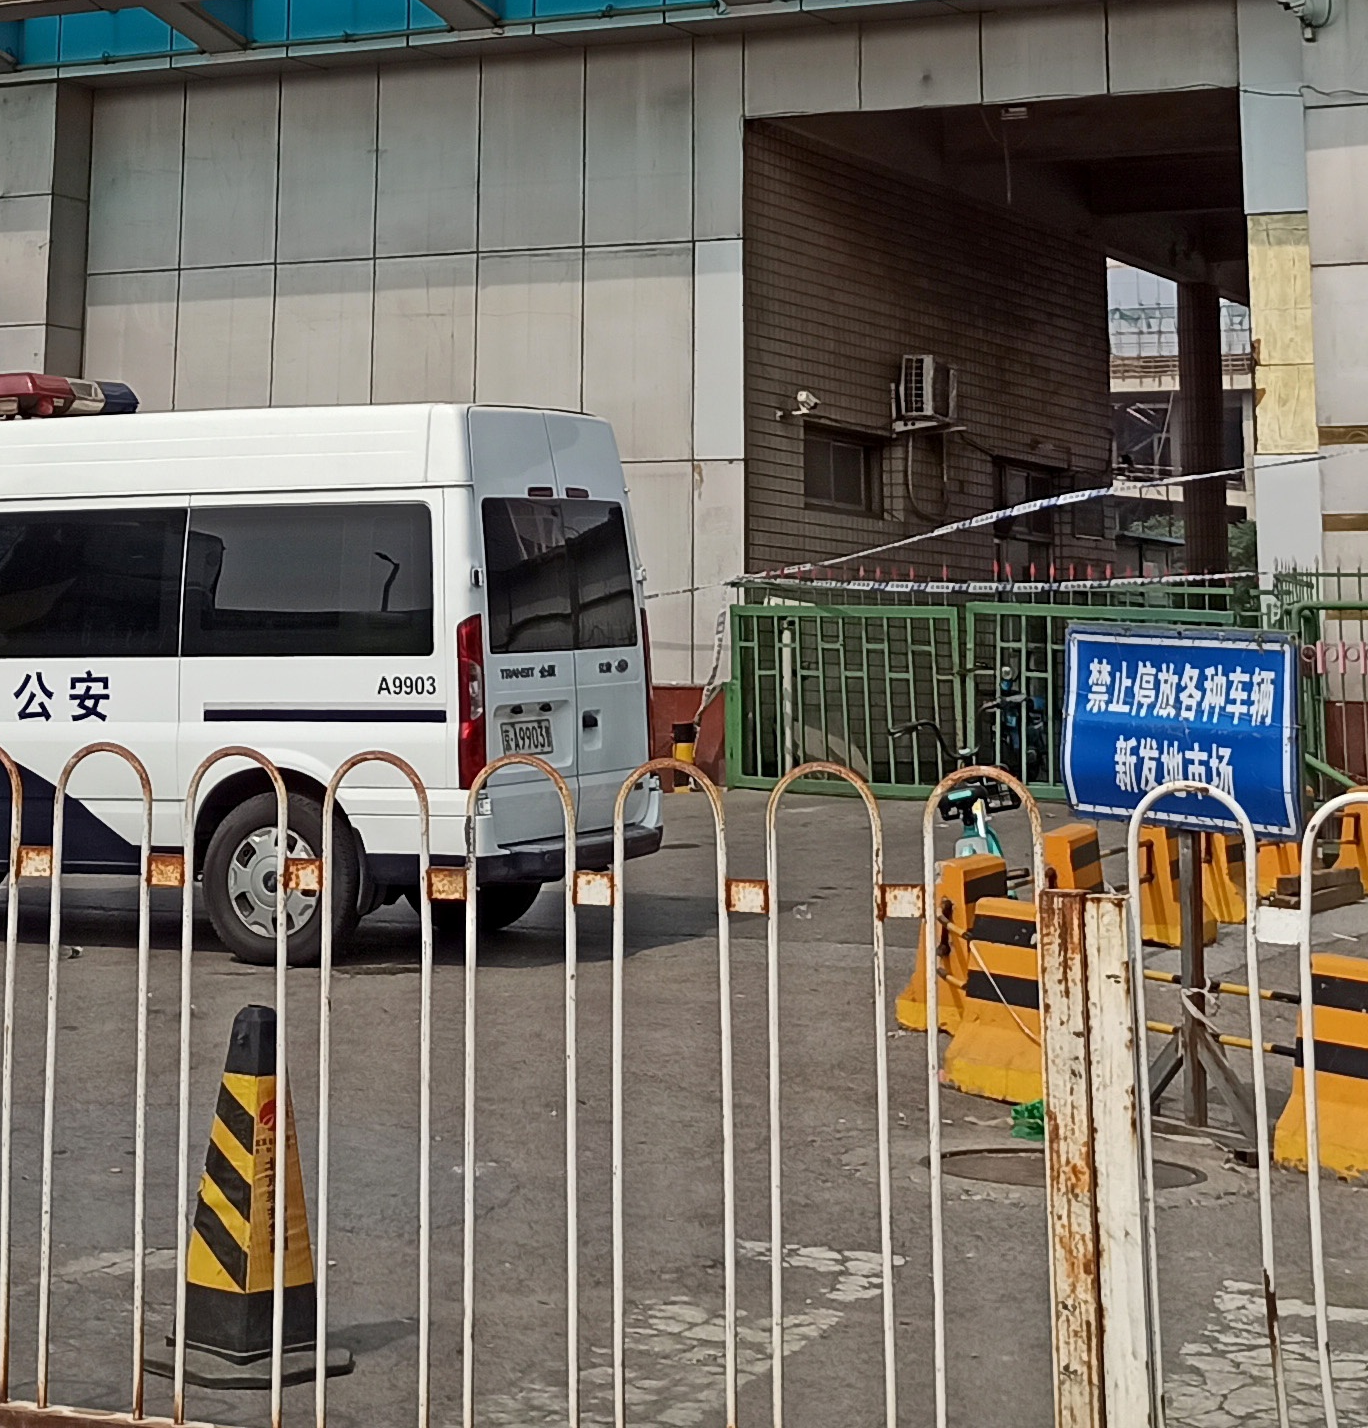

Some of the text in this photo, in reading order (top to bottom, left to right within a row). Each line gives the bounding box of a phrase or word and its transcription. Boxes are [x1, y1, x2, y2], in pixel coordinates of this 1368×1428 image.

[12, 669, 111, 723] 公安
[376, 675, 438, 697] A9903
[1085, 657, 1276, 727] 禁止停放各种车辆
[1114, 734, 1236, 800] 新发地市场
